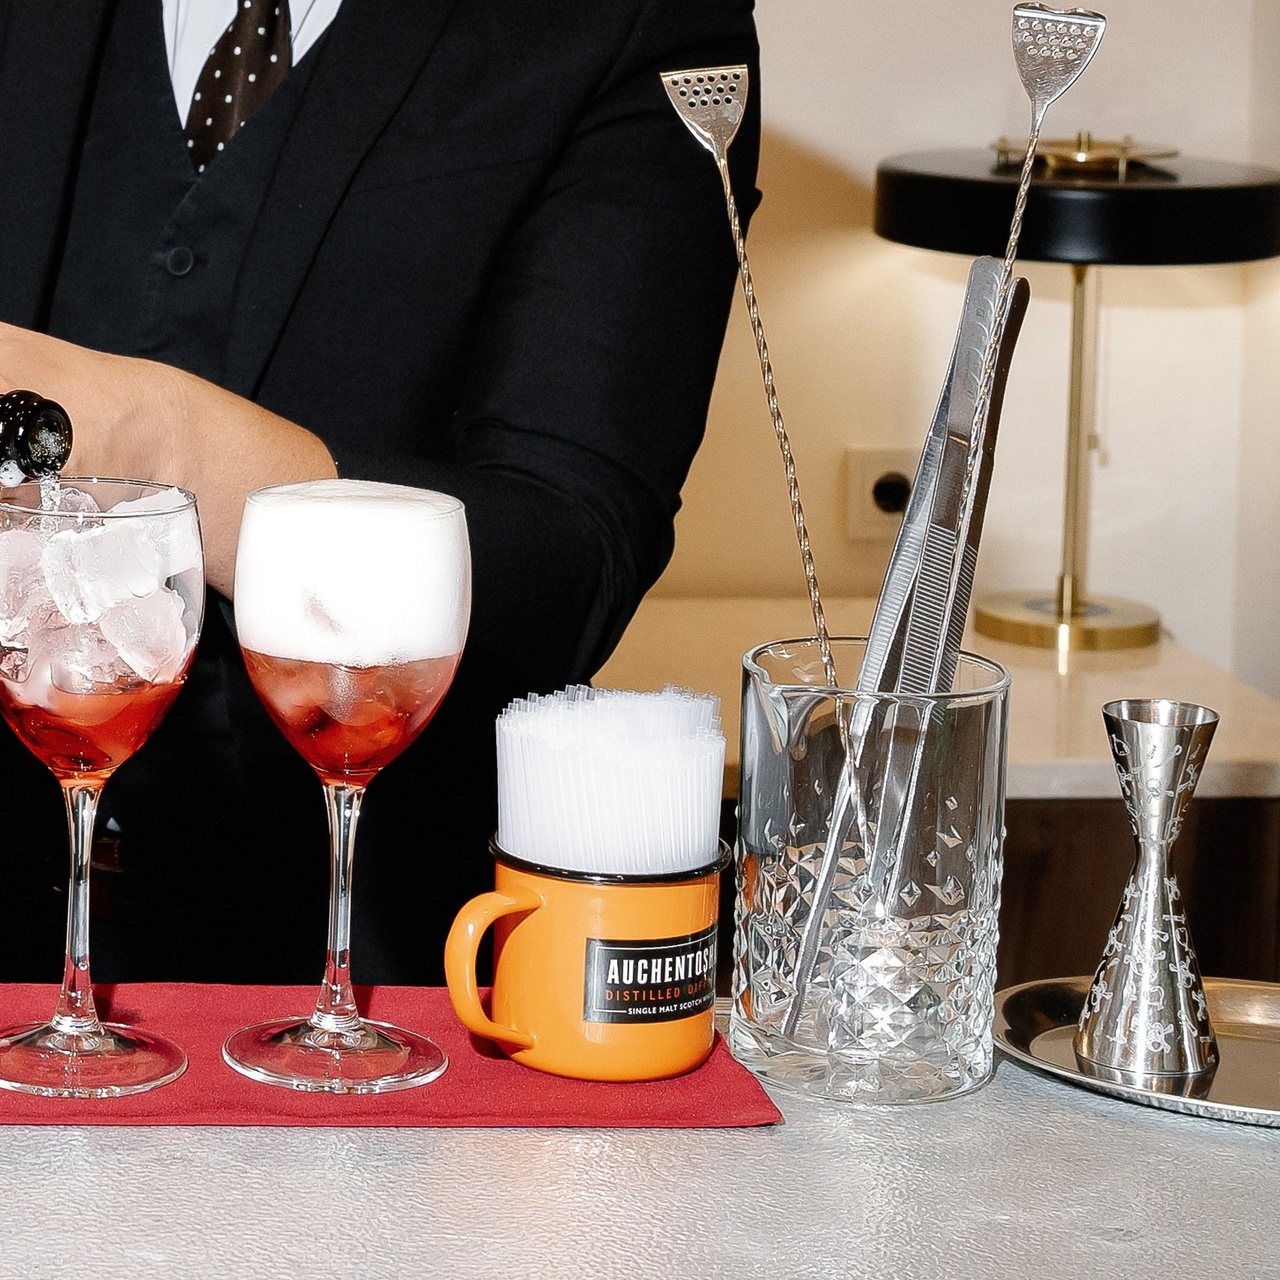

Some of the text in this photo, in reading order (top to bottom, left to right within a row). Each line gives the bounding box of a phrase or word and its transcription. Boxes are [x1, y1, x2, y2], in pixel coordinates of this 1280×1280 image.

[605, 987, 680, 1002] DISTILLED
[627, 998, 702, 1015] SINGLE MALT SCOTCH
